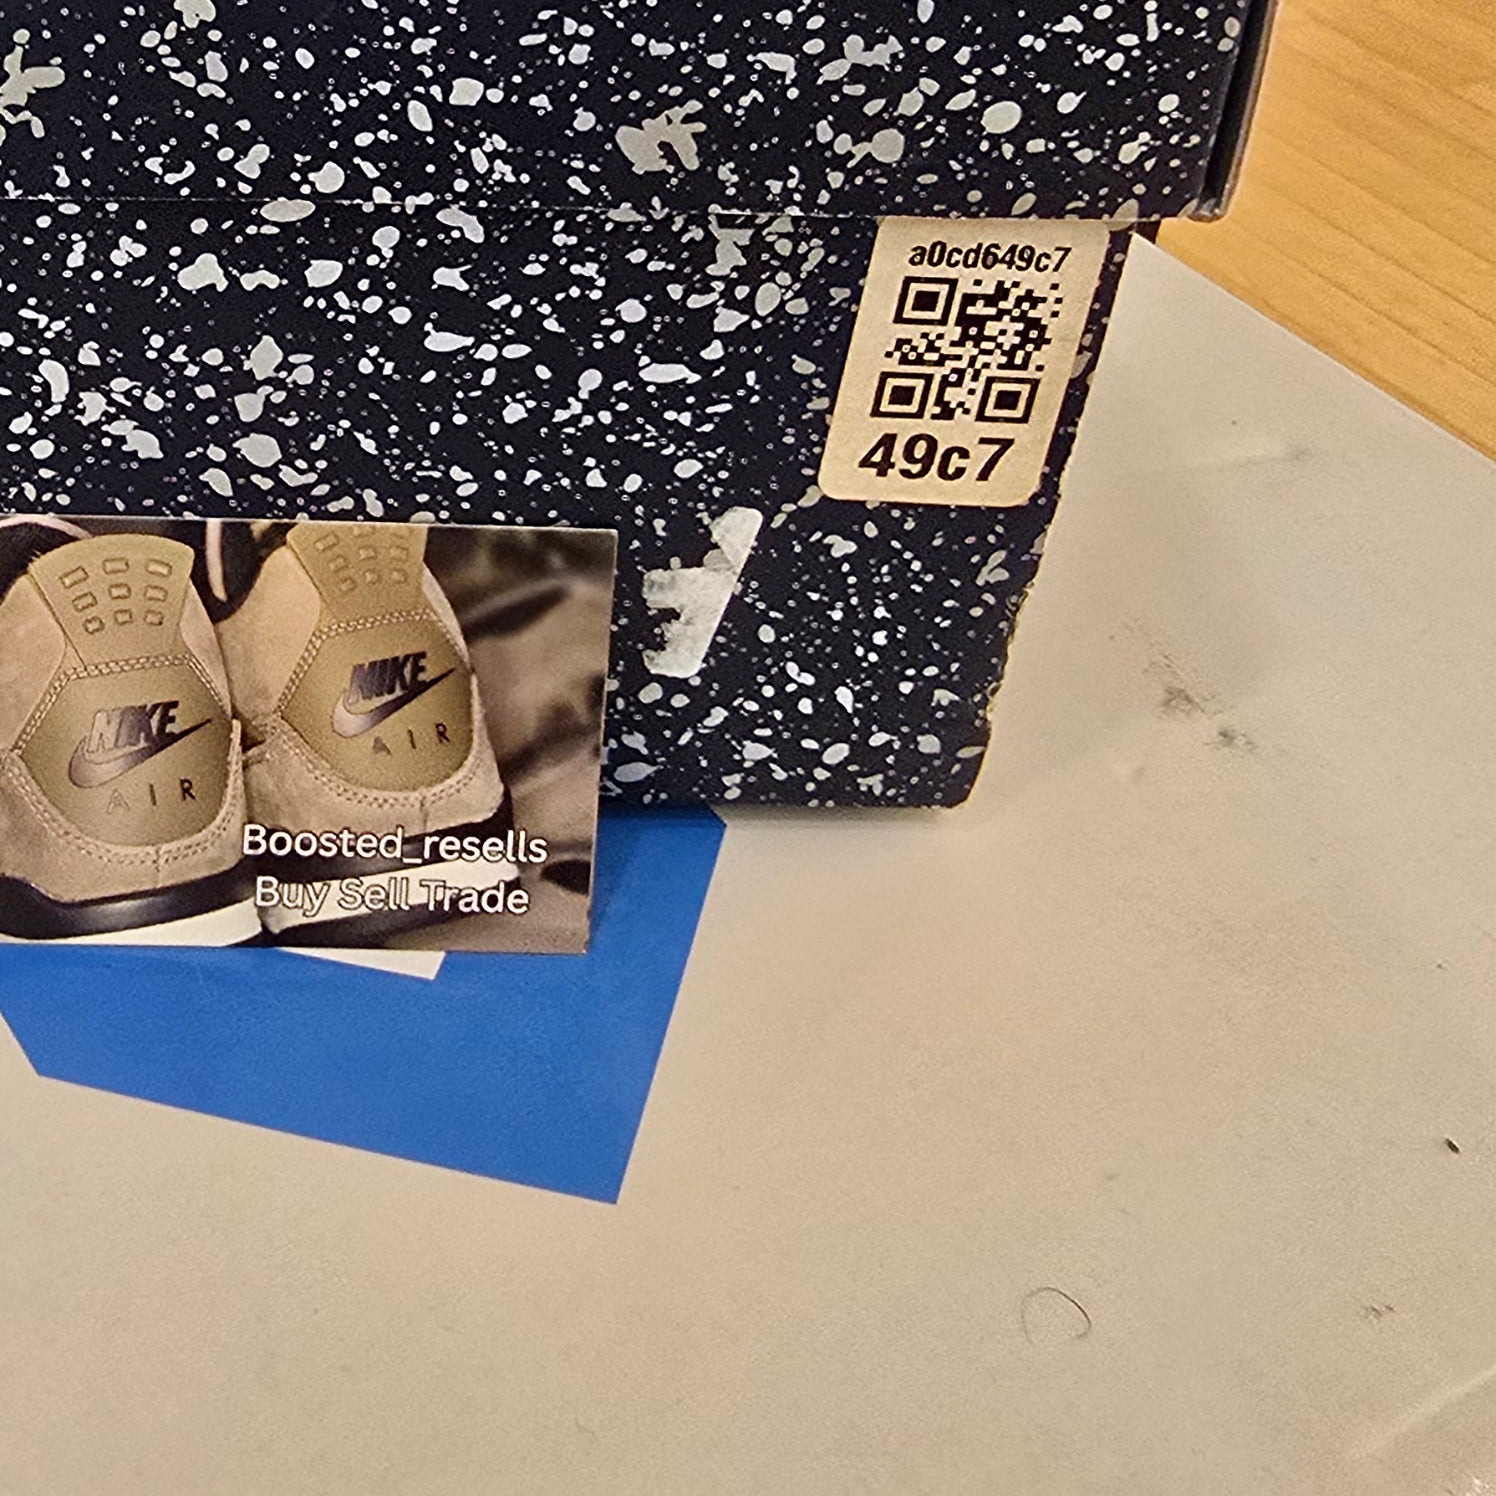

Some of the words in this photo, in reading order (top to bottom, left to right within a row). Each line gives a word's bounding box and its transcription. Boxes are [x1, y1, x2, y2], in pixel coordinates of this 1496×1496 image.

[908, 241, 1072, 273] a0cd649c7
[858, 432, 1016, 482] 49c7
[348, 651, 427, 704] NIKE
[87, 700, 179, 753] NIKE
[372, 723, 451, 756] AIR
[106, 778, 196, 814] AIR
[242, 824, 548, 863] Boosted_resells
[255, 875, 330, 917] Buy
[338, 877, 411, 912] Sell
[419, 880, 529, 913] Trade
